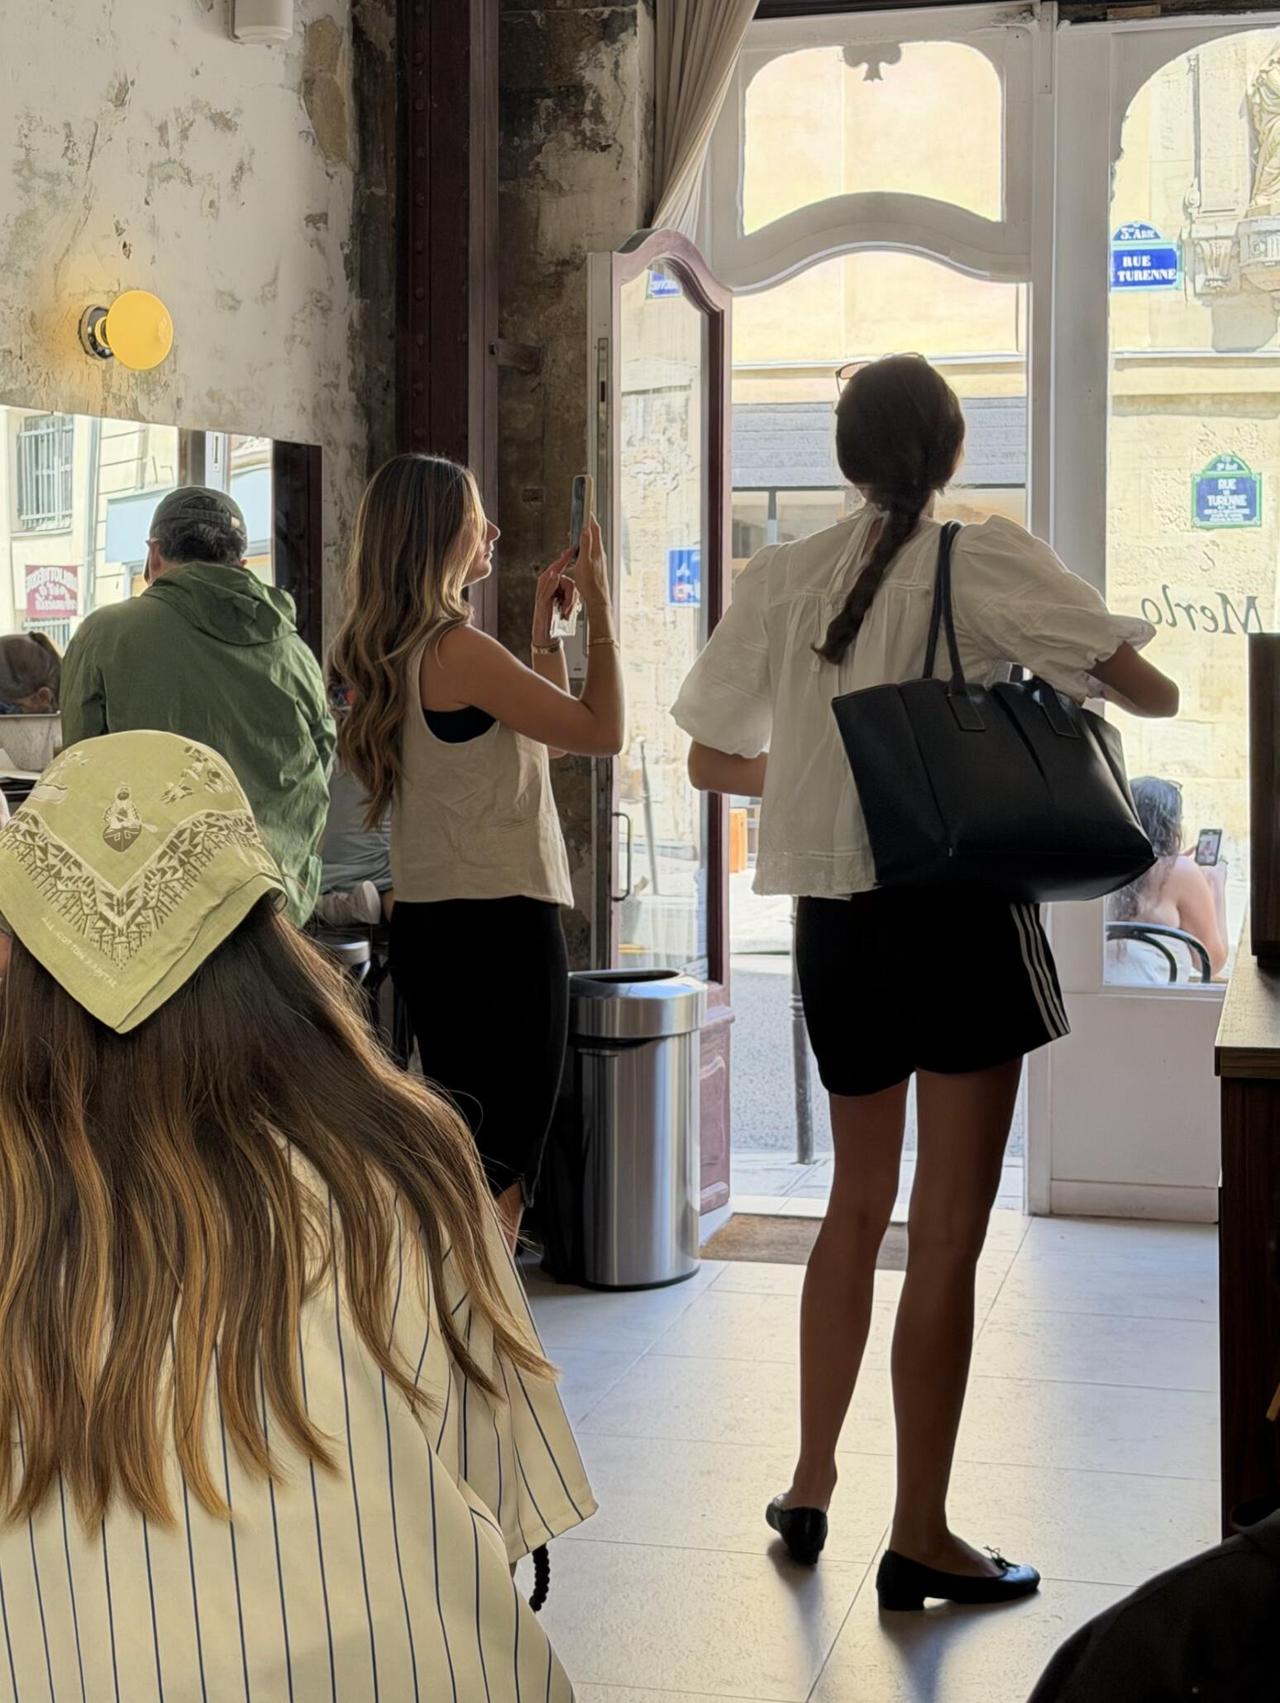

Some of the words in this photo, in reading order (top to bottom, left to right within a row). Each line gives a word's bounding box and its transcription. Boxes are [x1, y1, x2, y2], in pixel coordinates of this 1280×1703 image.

[1122, 256, 1152, 268] RUE
[1117, 268, 1176, 282] TURENNE
[1217, 478, 1237, 491] RUE
